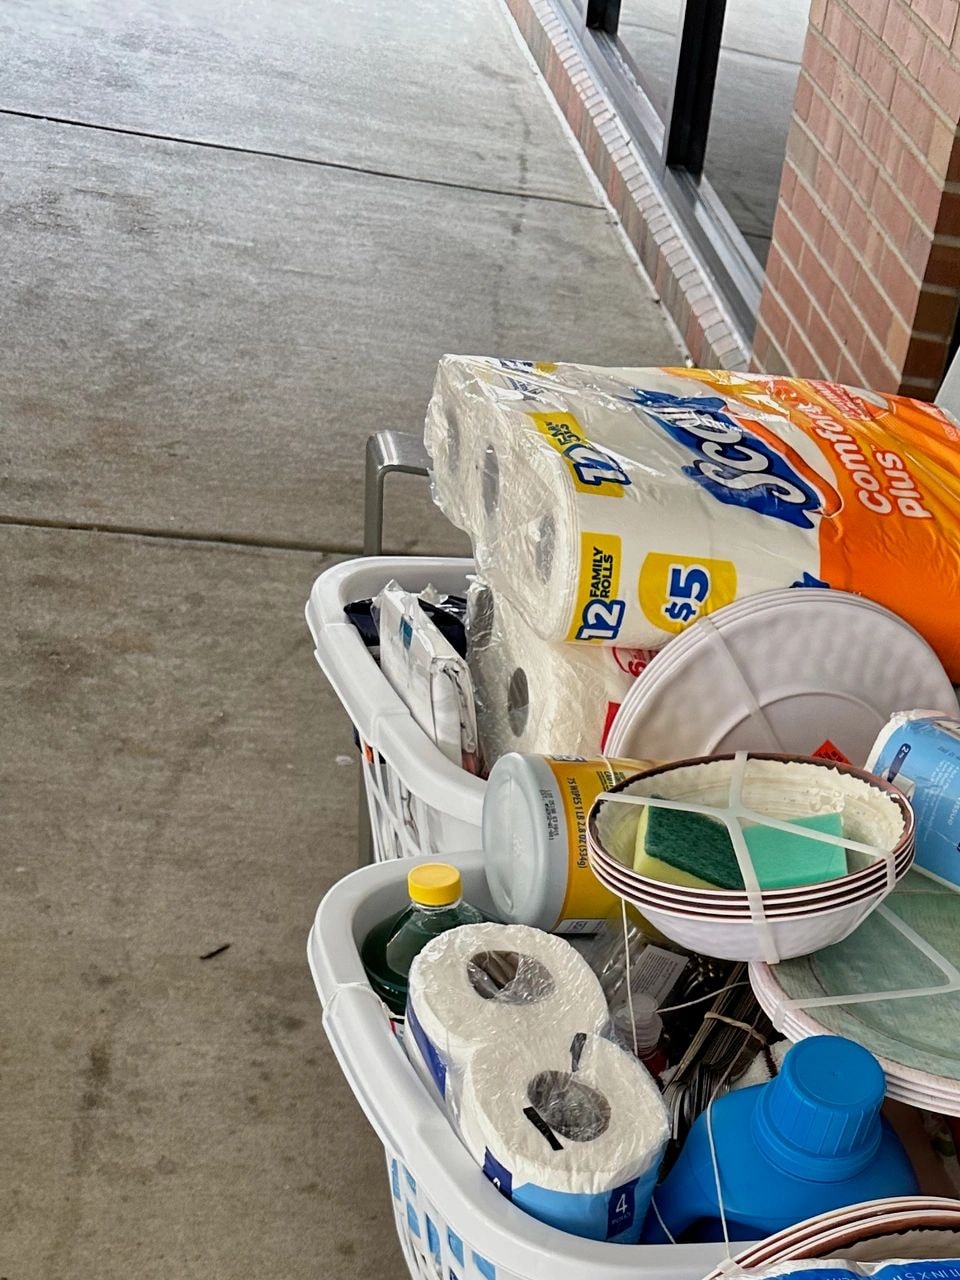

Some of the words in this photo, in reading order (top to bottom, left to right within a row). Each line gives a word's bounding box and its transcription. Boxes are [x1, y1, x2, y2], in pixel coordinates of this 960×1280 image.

[643, 407, 807, 504] Sco
[876, 449, 932, 518] Plus
[590, 547, 604, 598] FAMILY
[601, 553, 614, 599] ROLLS
[663, 566, 709, 622] $5
[576, 599, 627, 643] 12
[569, 783, 582, 805] WIPES
[575, 810, 584, 820] LB
[576, 820, 586, 832] 2.8
[577, 833, 587, 844] OZ
[577, 844, 588, 868] (534g)
[612, 1192, 629, 1214] 4
[929, 1267, 949, 1280] IN
